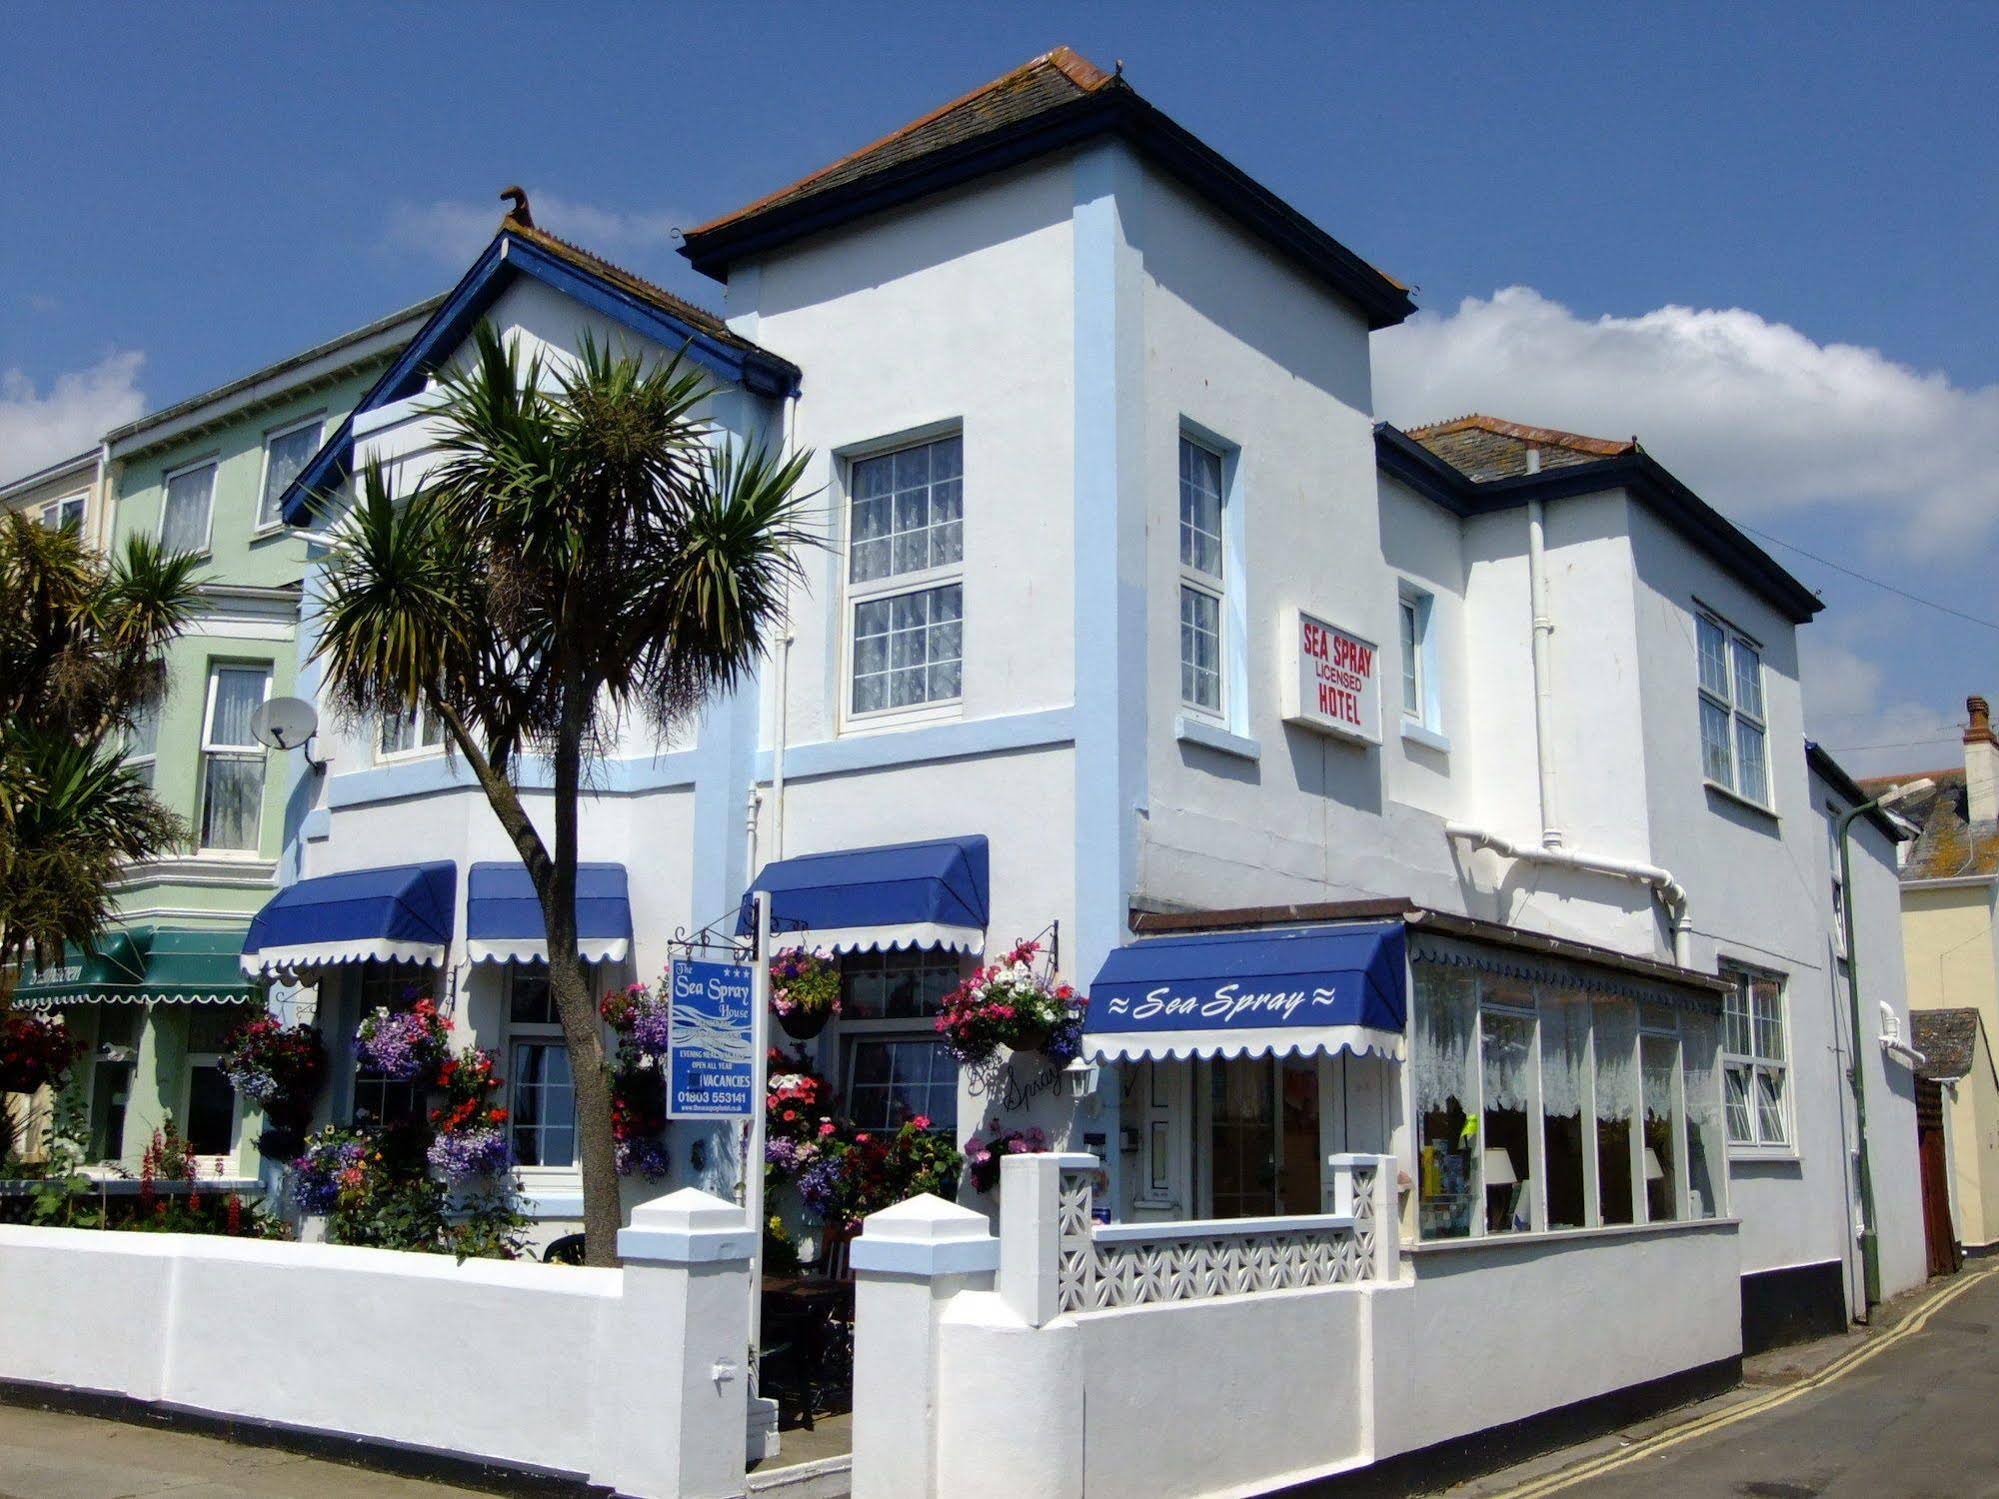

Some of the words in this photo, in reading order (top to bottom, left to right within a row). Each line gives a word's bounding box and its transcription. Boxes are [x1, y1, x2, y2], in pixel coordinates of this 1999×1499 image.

[1304, 623, 1329, 662] SEA
[1334, 635, 1372, 678] SPRAY
[1315, 660, 1362, 692] LICENSED
[1319, 682, 1361, 725] HOTEL
[675, 962, 692, 975] The
[675, 975, 703, 997] Sea
[707, 978, 749, 1006] Spray
[719, 1003, 749, 1018] House
[1133, 987, 1199, 1020] Sea
[1201, 983, 1306, 1023] Spray
[691, 1061, 707, 1069] OPEN
[707, 1062, 717, 1070] ALL
[718, 1062, 733, 1070] YEAR
[703, 1074, 751, 1088] VACANCIES
[678, 1091, 710, 1104] 01803
[711, 1092, 746, 1104] 553141
